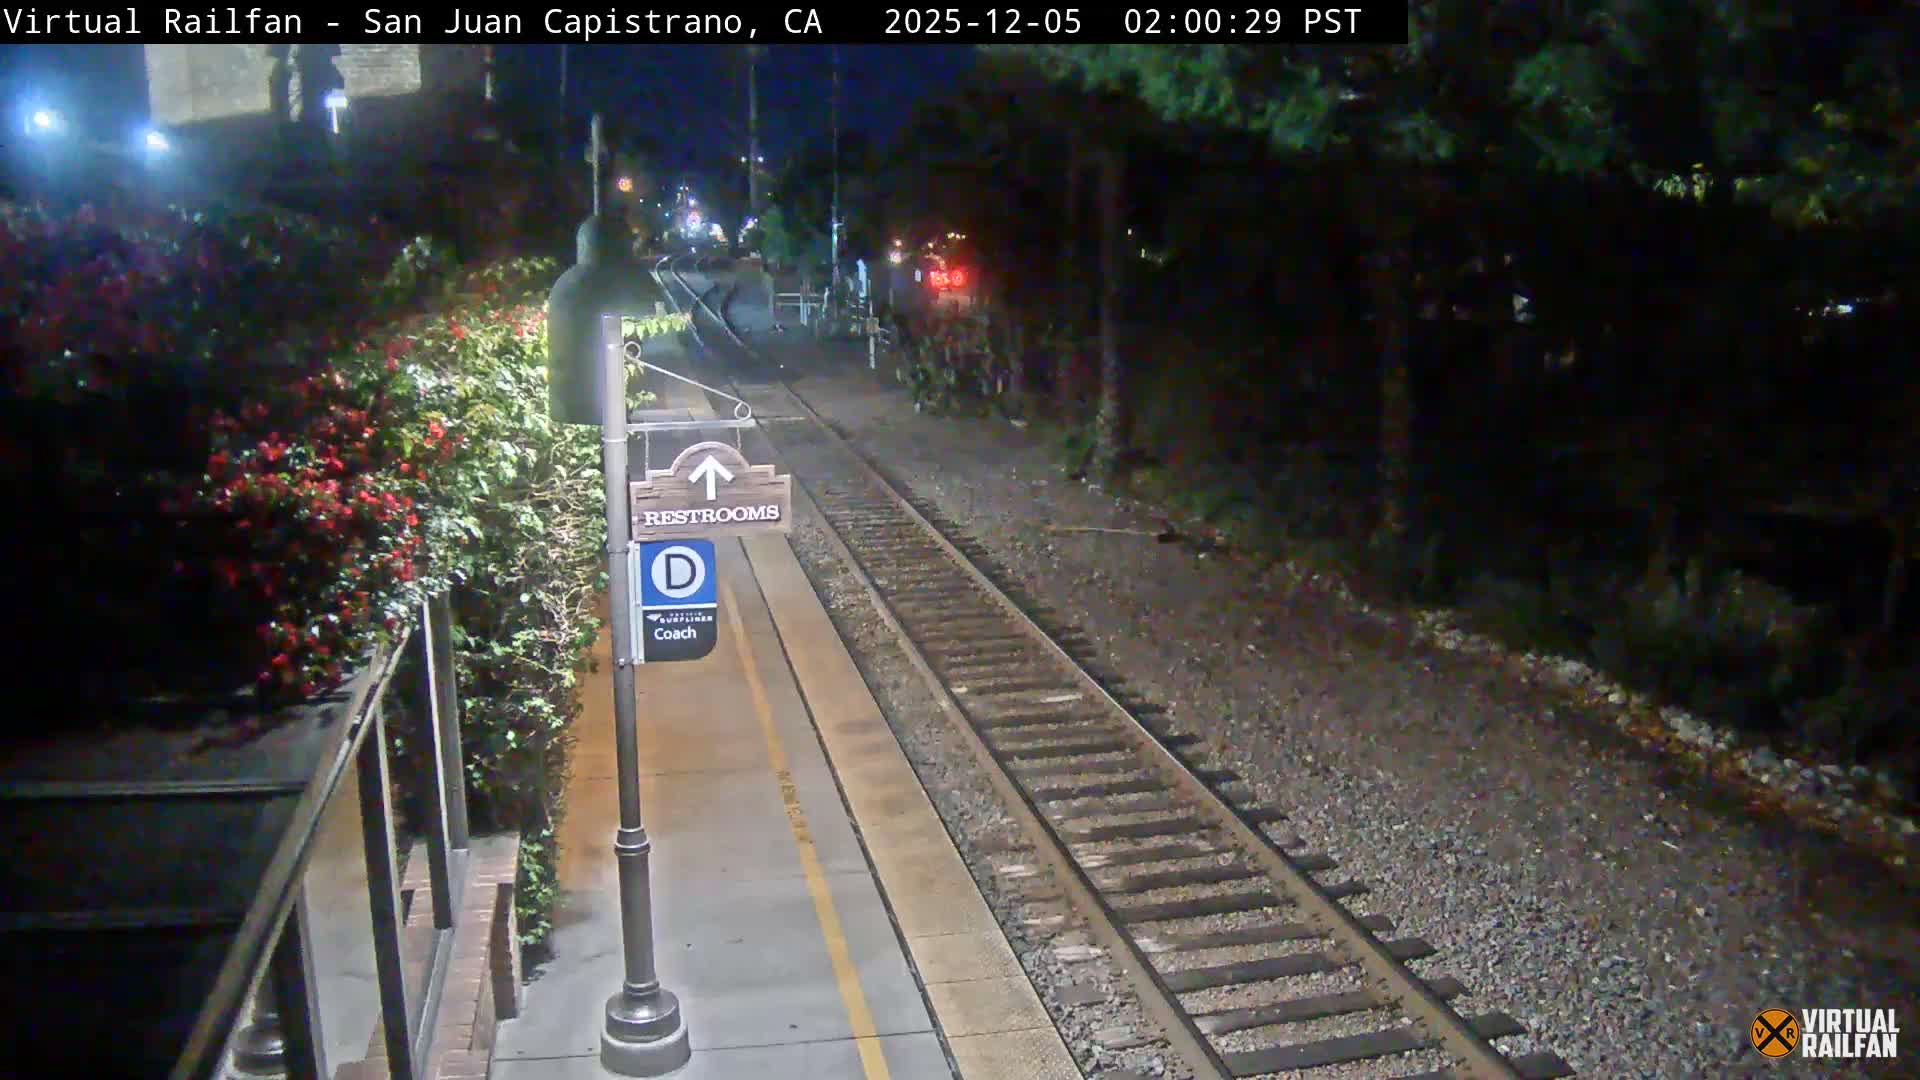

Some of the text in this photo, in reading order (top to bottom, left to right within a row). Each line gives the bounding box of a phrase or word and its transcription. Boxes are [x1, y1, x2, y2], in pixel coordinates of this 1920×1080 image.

[643, 504, 780, 526] RESTROOMS
[665, 553, 697, 590] D
[654, 625, 697, 640] Coach
